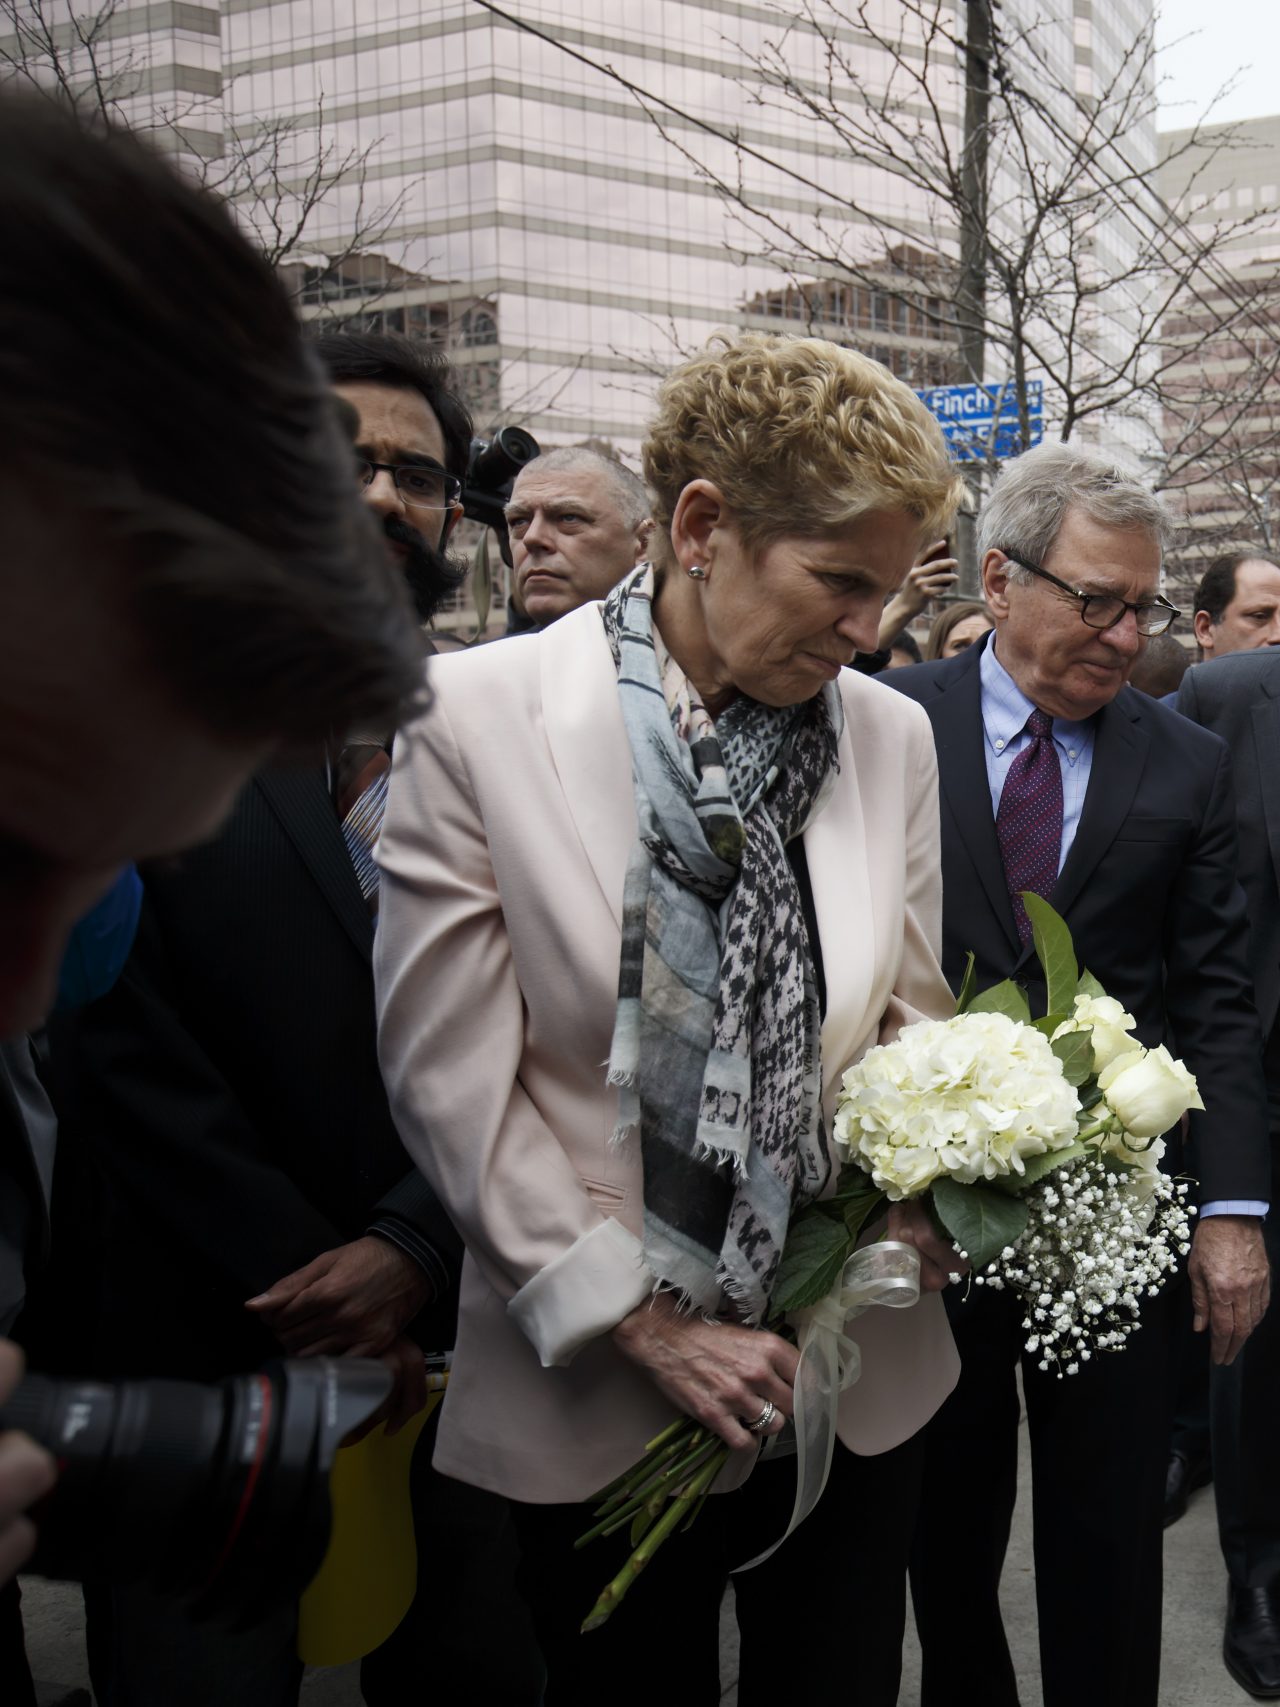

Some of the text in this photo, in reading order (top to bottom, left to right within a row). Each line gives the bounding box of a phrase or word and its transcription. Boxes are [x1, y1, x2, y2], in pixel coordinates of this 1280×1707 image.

[930, 387, 989, 415] Finch
[803, 997, 817, 1034] AWAY
[802, 1043, 814, 1077] WISH
